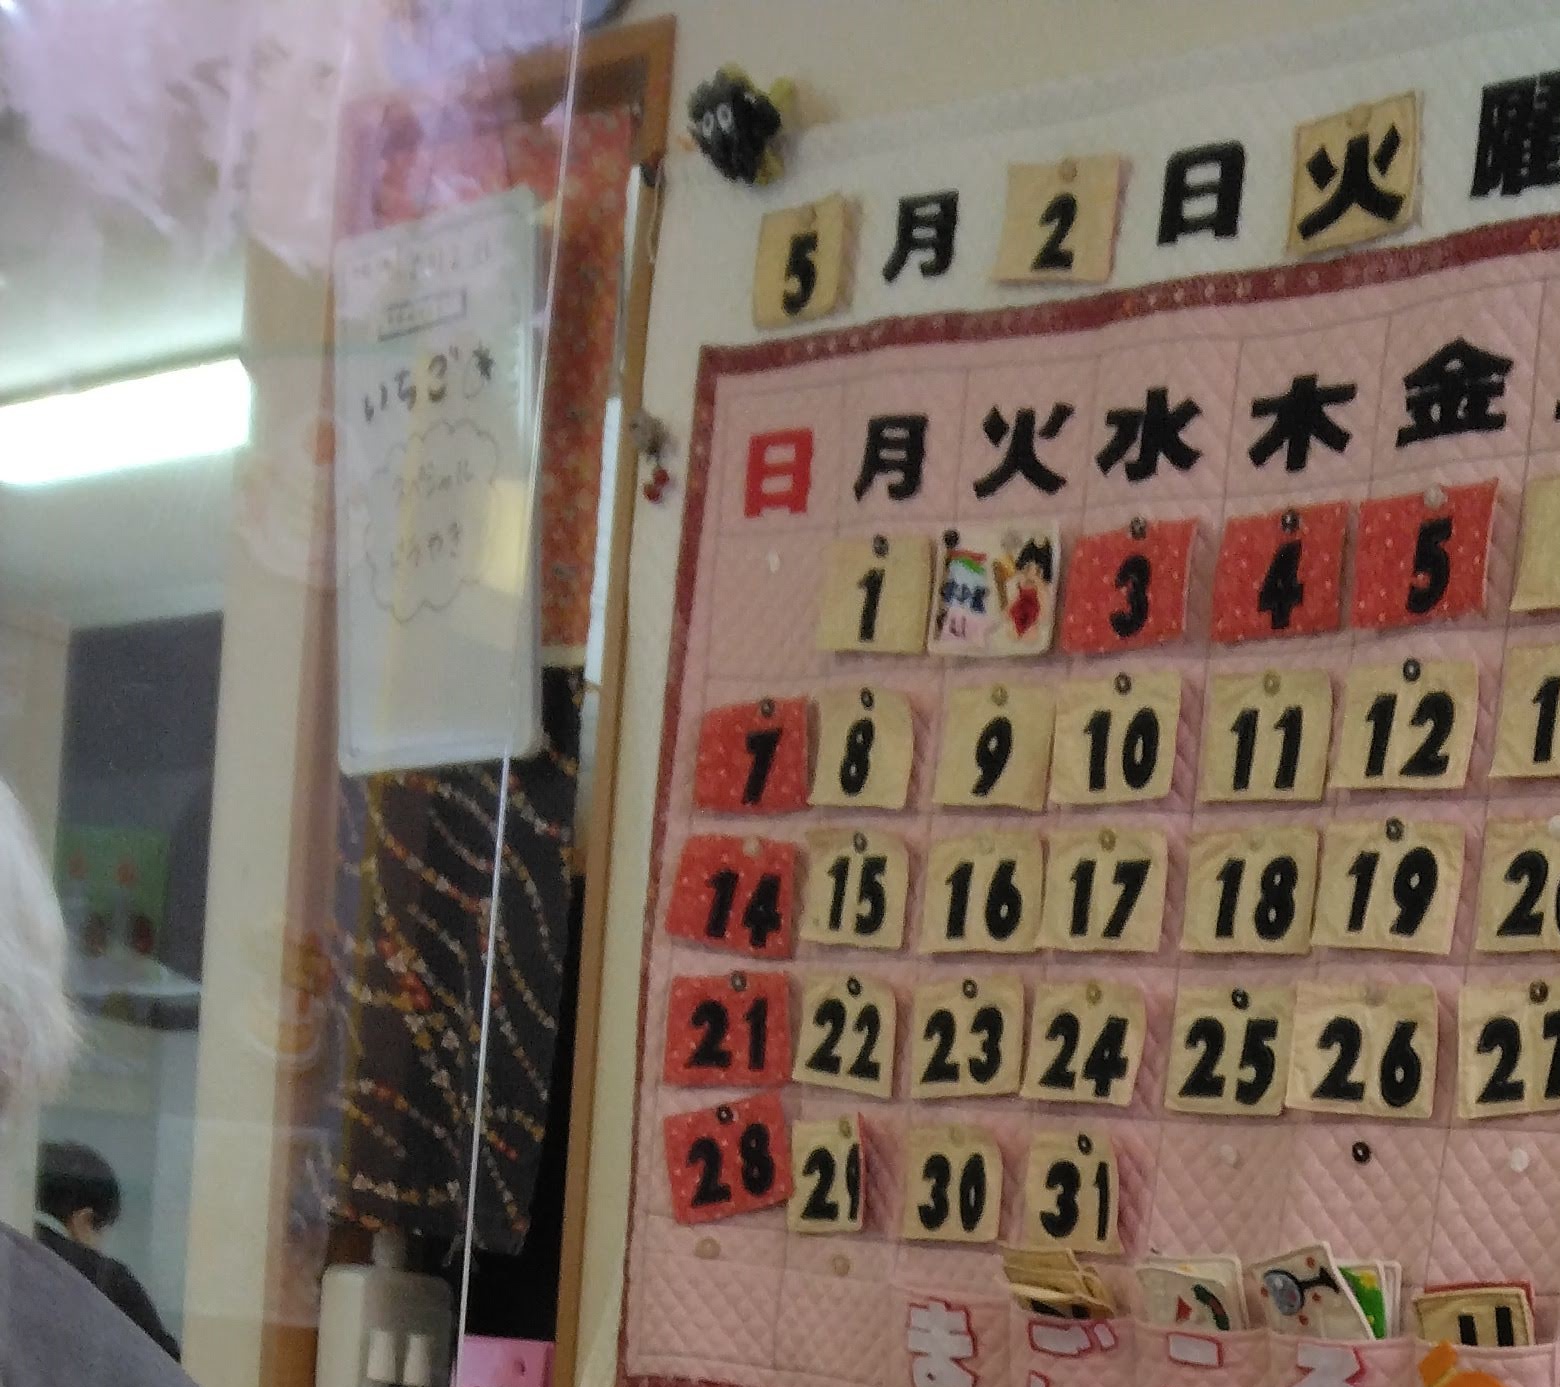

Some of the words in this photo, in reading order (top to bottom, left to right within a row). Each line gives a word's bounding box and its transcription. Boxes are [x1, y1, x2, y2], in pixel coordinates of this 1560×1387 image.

[745, 428, 813, 518] 日
[852, 414, 930, 503] 月
[972, 403, 1076, 500] 火
[1095, 386, 1203, 483] 水
[1247, 373, 1358, 475] 木
[1394, 337, 1515, 449] 金
[858, 568, 885, 642] 1
[1108, 553, 1153, 636] 3
[1256, 538, 1306, 632] 4
[1405, 514, 1454, 617] 5
[741, 726, 783, 807] 7
[838, 717, 876, 797] 8
[971, 715, 1014, 798] 9
[1083, 706, 1161, 792] 10
[1229, 705, 1304, 792] 11
[1364, 689, 1456, 779] 12
[704, 867, 783, 950] 14
[826, 855, 888, 937] 15
[945, 859, 1024, 941] 16
[1069, 858, 1152, 940] 17
[1214, 854, 1300, 942] 18
[1346, 846, 1439, 938] 19
[687, 996, 770, 1071] 21
[805, 998, 882, 1082] 22
[920, 1005, 1005, 1085] 23
[1038, 1011, 1130, 1099] 24
[1177, 1016, 1280, 1107] 25
[1311, 1016, 1423, 1109] 26
[686, 1124, 777, 1208] 28
[916, 1152, 988, 1234] 30
[1039, 1159, 1111, 1242] 31
